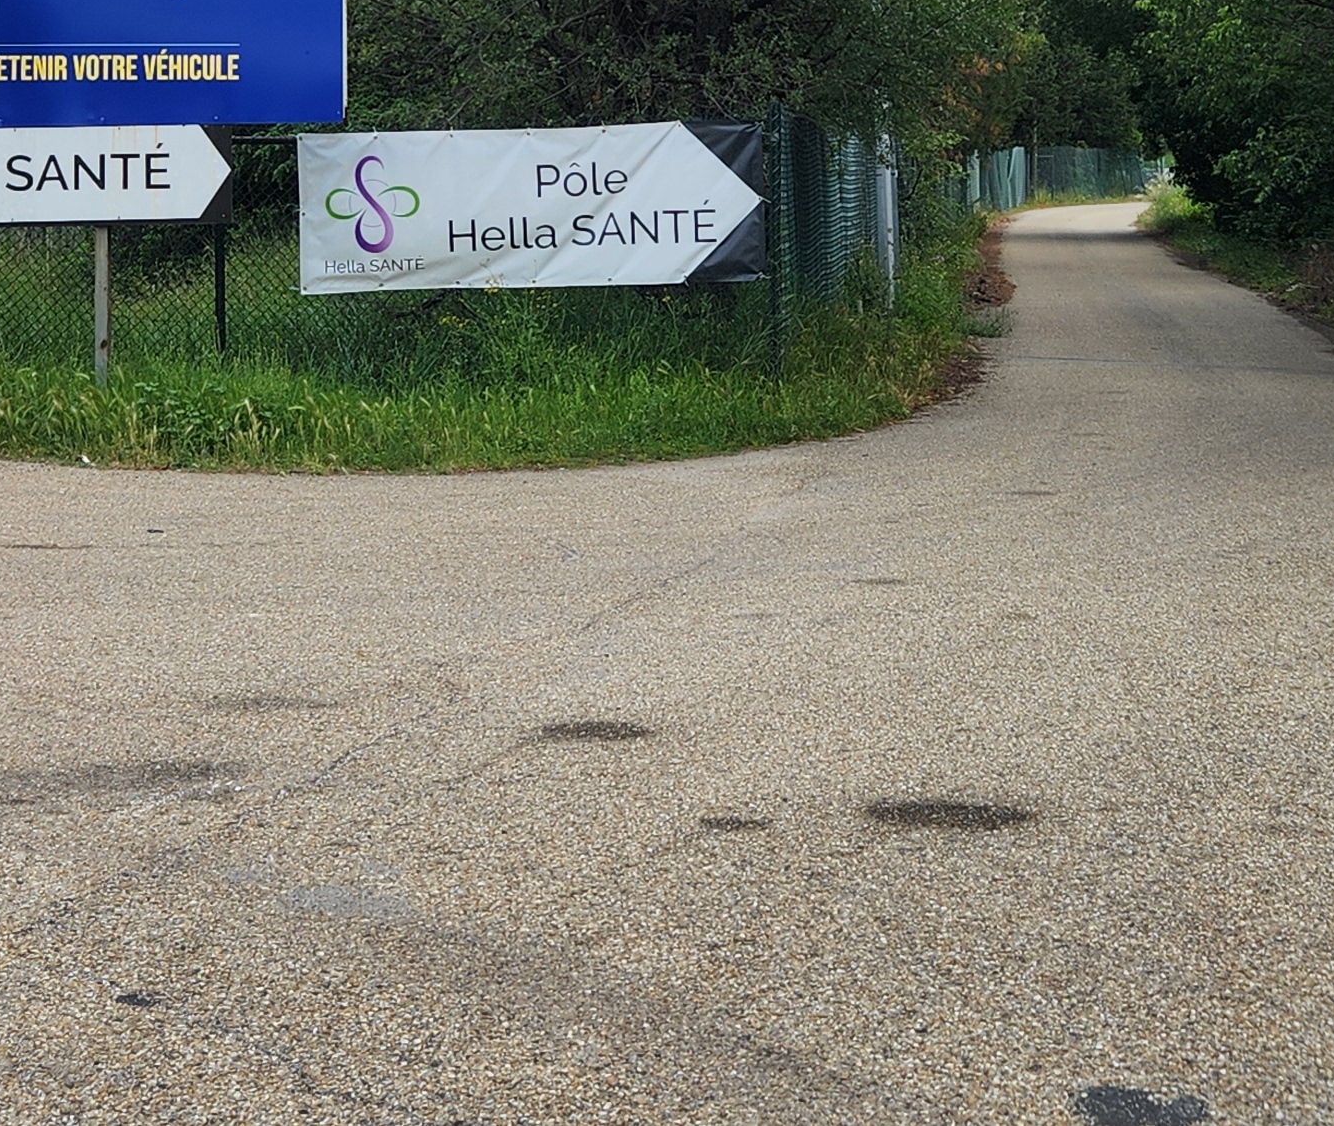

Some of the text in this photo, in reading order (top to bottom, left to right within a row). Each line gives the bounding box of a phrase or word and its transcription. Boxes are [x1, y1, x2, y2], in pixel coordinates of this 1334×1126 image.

[73, 54, 138, 80] VOTRE
[143, 48, 240, 80] VÉHICULE
[5, 142, 171, 192] SANTÉ
[536, 162, 628, 198] Pôle
[448, 199, 718, 252] Hella SANTÉ
[324, 255, 426, 274] Hella SANTÉ
